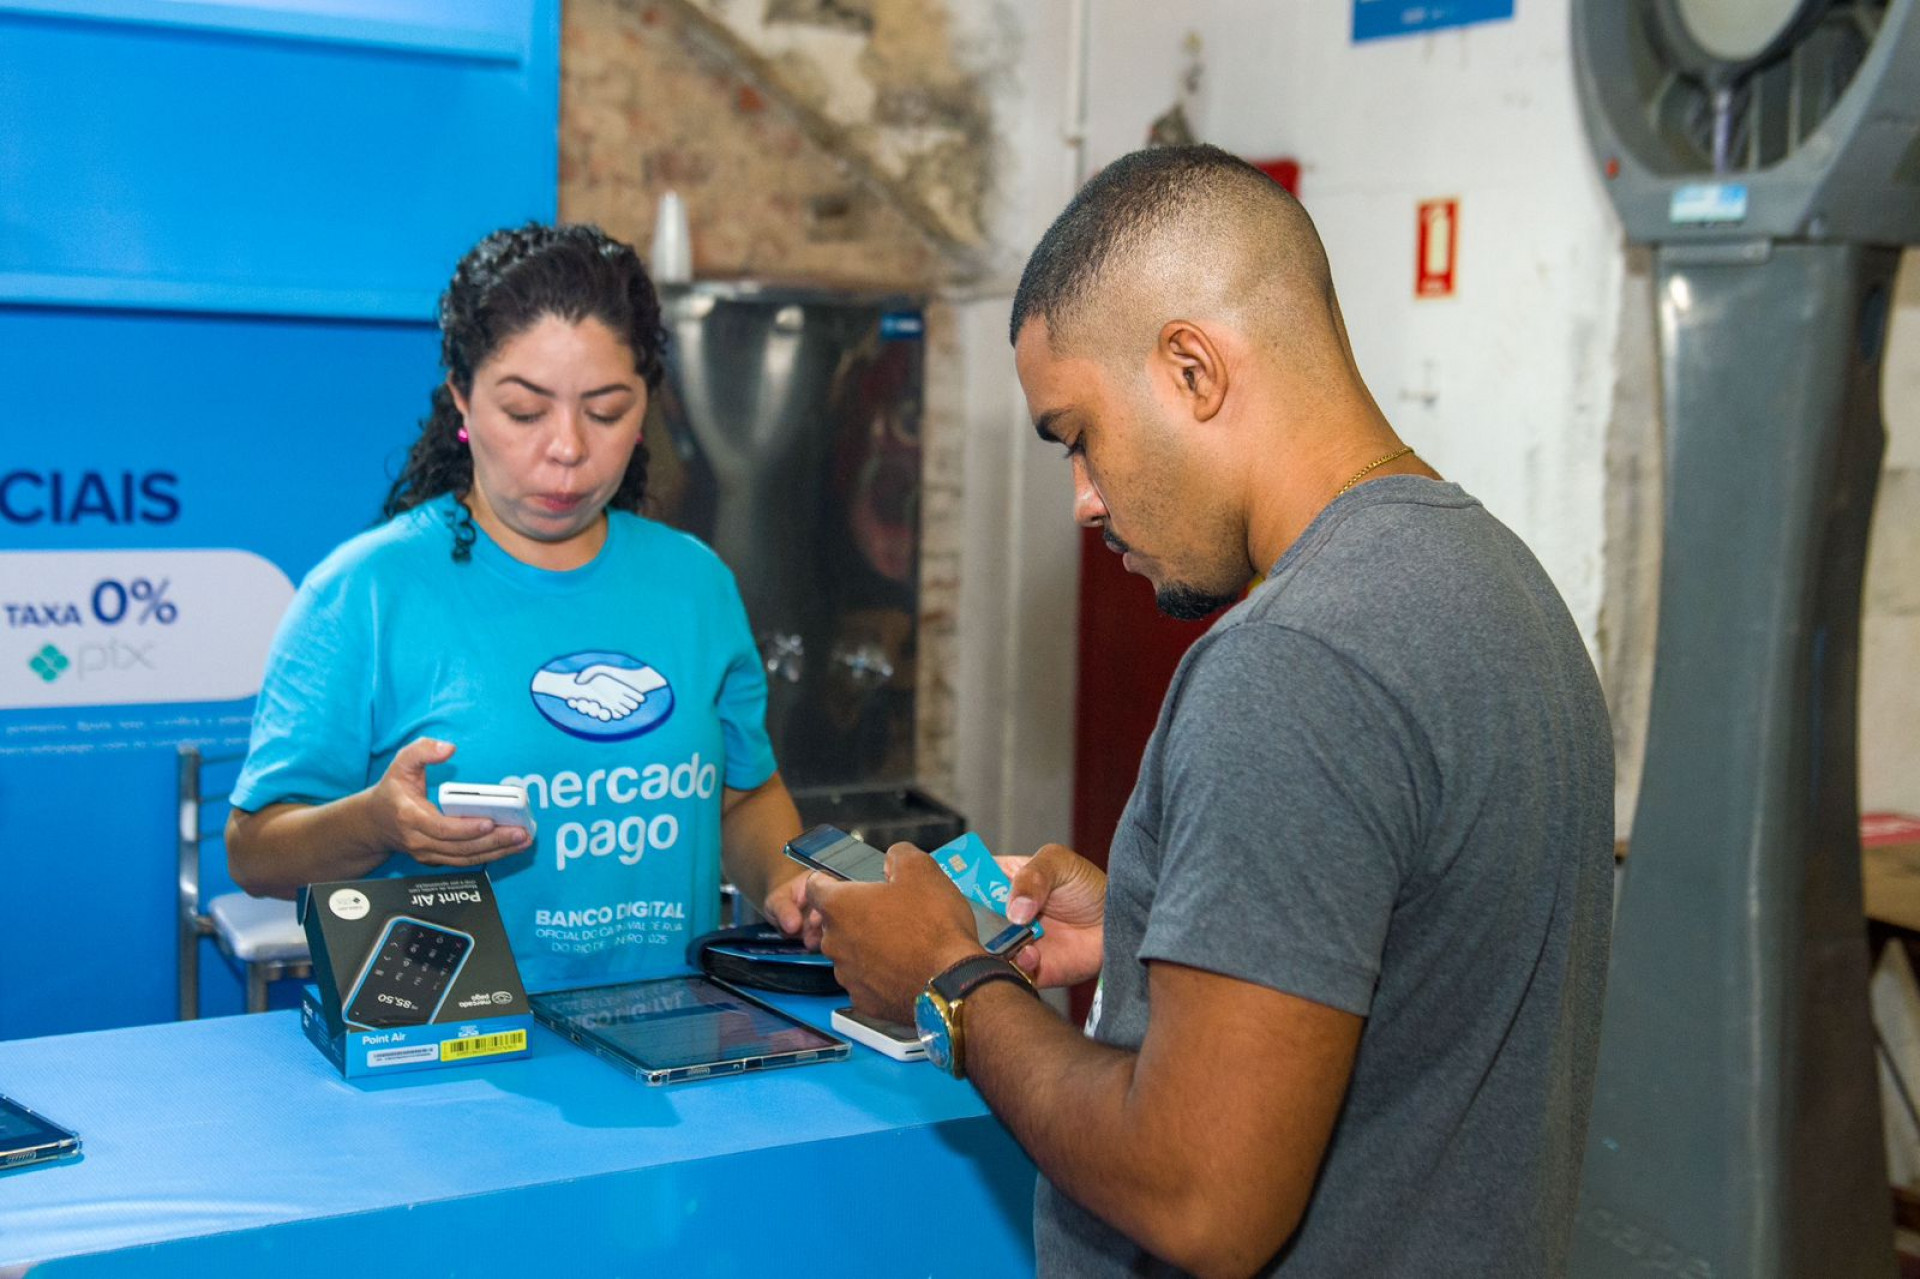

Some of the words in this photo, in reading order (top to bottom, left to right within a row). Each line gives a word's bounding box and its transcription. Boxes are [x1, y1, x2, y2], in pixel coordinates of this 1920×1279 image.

[0, 470, 180, 525] CIAIS
[5, 604, 82, 627] TAXA
[91, 577, 178, 625] 0%
[77, 637, 155, 680] pix
[556, 814, 679, 871] pago
[411, 894, 434, 907] Air
[438, 891, 482, 904] Point
[535, 907, 612, 927] BANCO
[616, 901, 685, 920] DIGITAL
[362, 1034, 389, 1045] Point
[391, 1032, 408, 1042] Air
